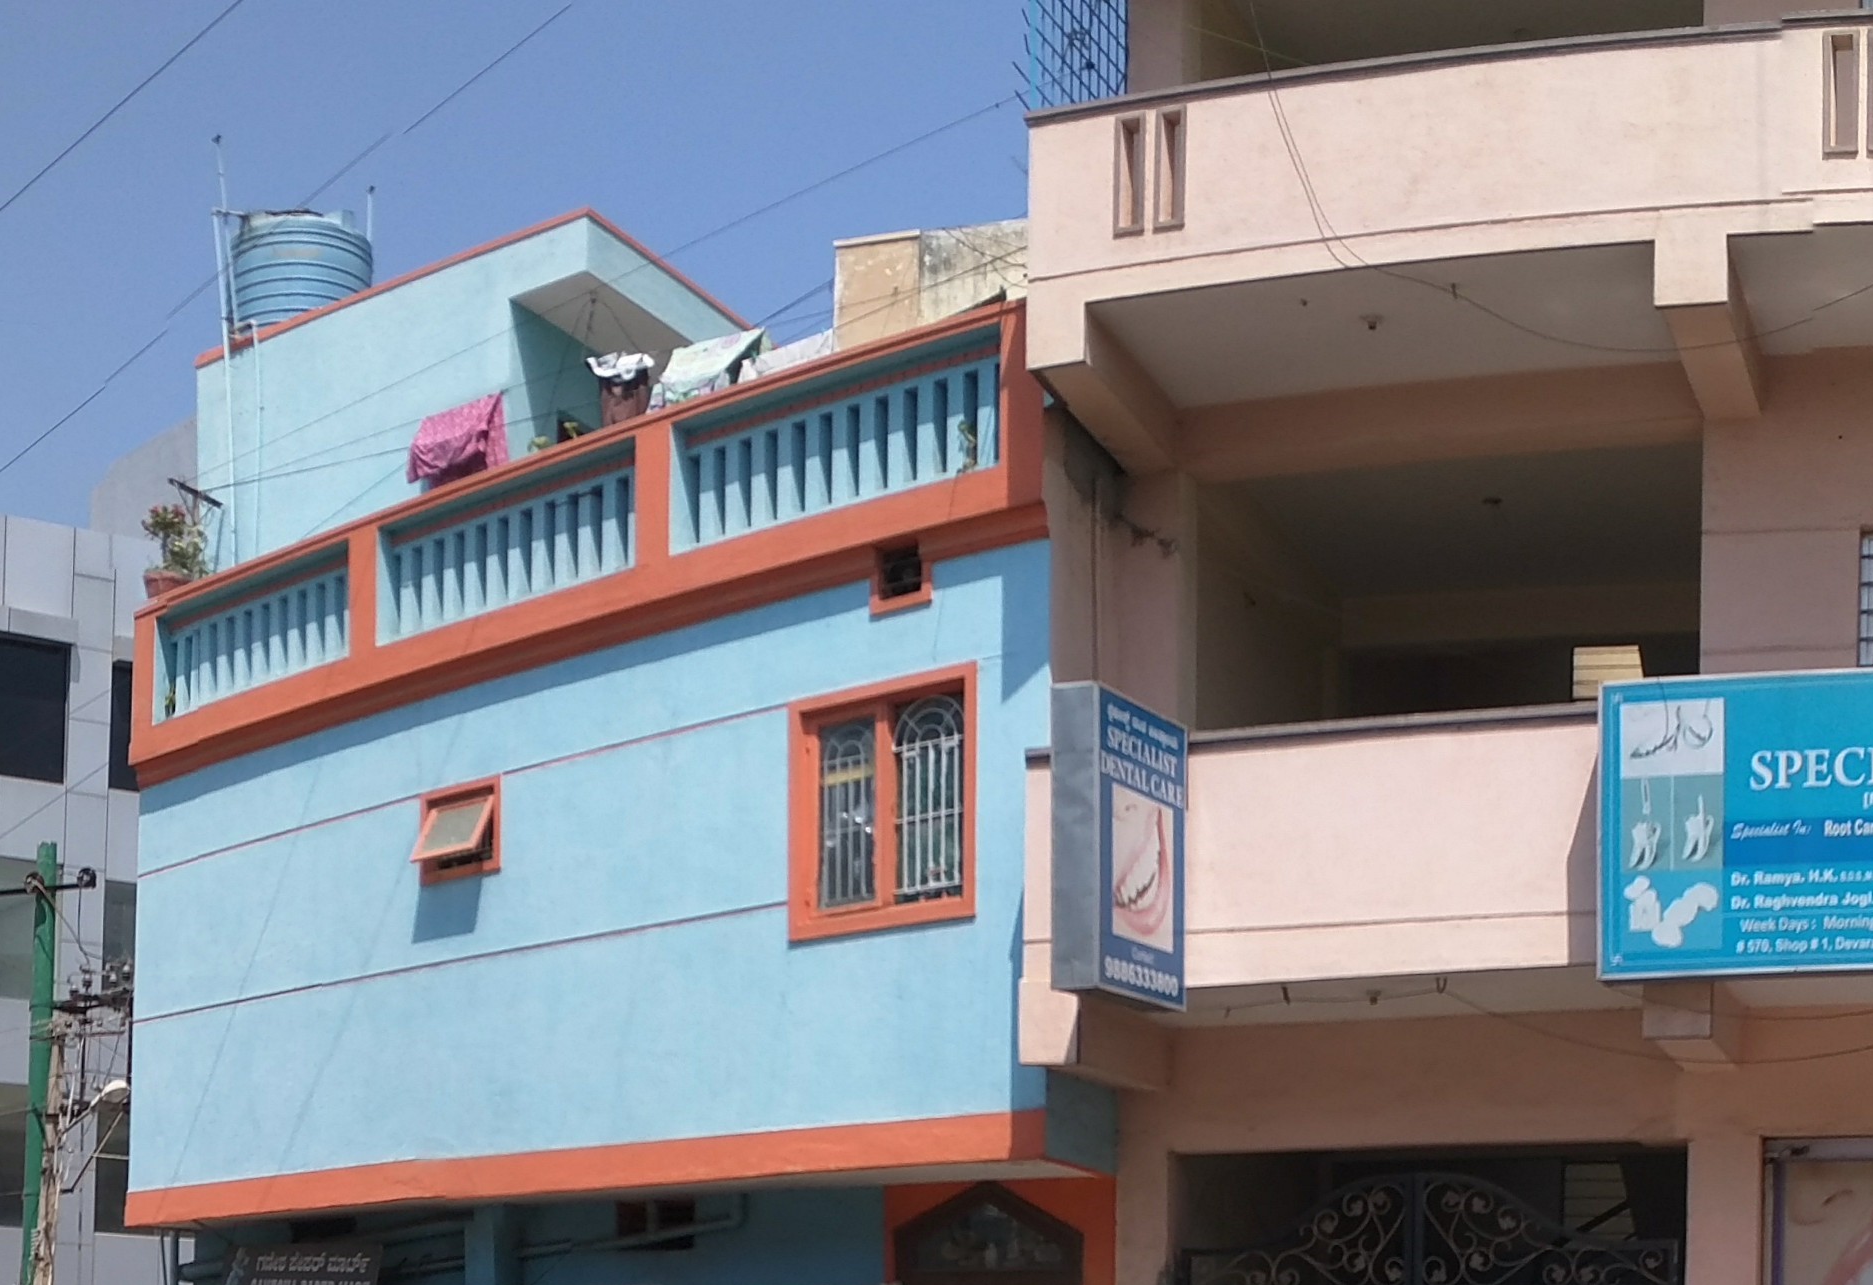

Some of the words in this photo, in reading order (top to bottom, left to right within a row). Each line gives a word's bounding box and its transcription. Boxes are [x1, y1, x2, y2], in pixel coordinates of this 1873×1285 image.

[1106, 725, 1178, 776] SPECIALIST
[1101, 750, 1149, 793] DENTAL
[1150, 776, 1184, 810] CARE
[1824, 818, 1852, 838] Root
